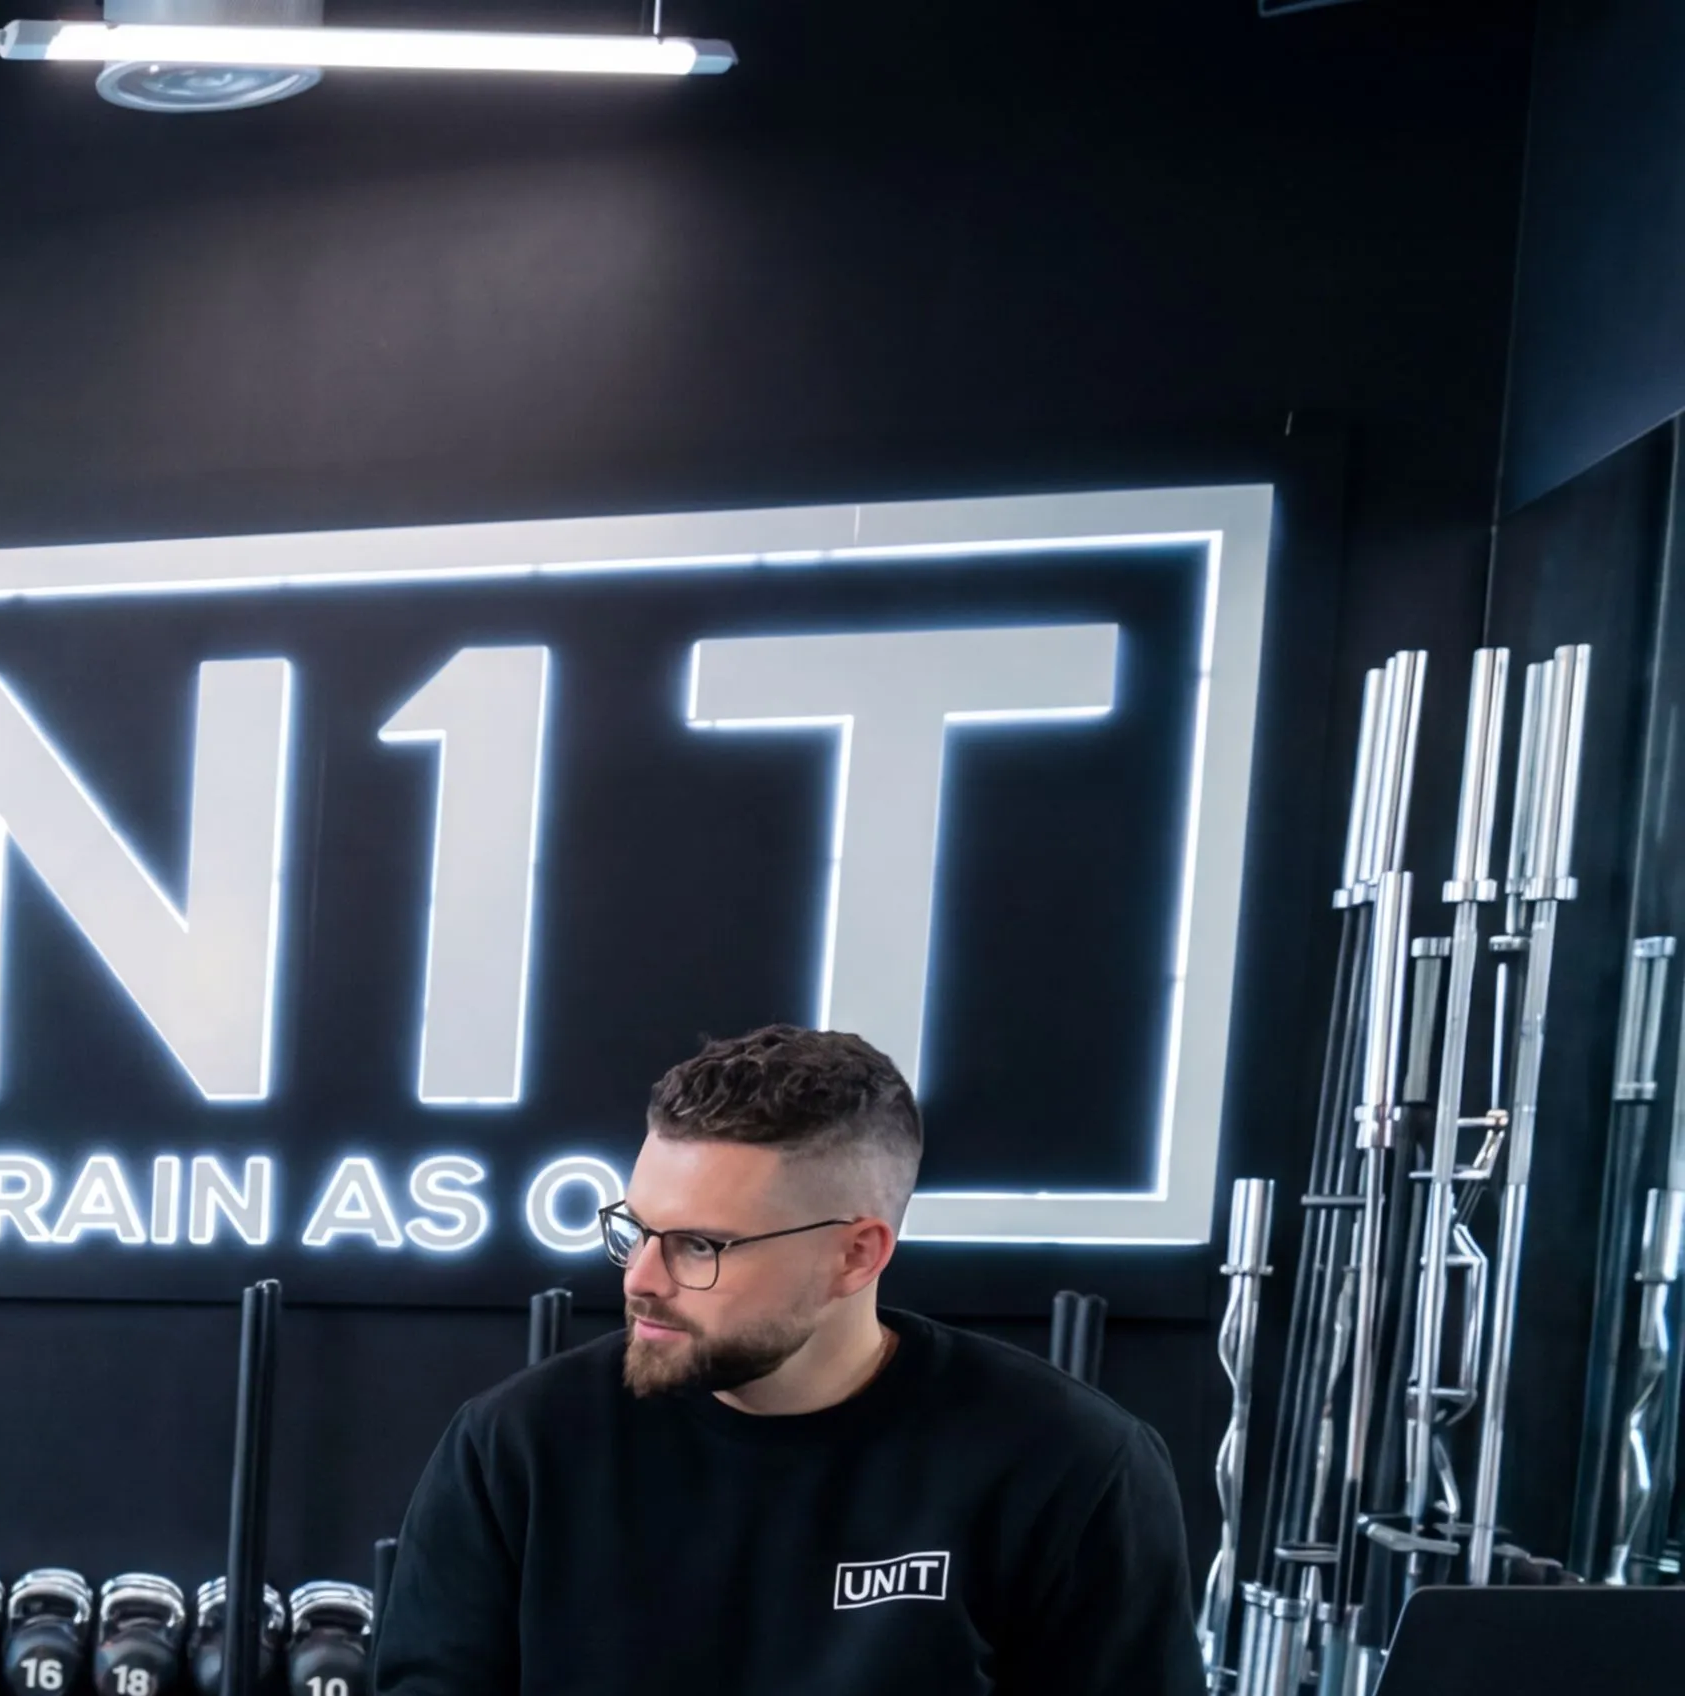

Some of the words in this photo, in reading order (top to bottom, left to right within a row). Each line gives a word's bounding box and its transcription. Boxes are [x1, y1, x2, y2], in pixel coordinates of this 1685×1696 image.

[301, 1154, 489, 1252] AS
[843, 1560, 940, 1601] UNIT
[20, 1657, 64, 1690] 16
